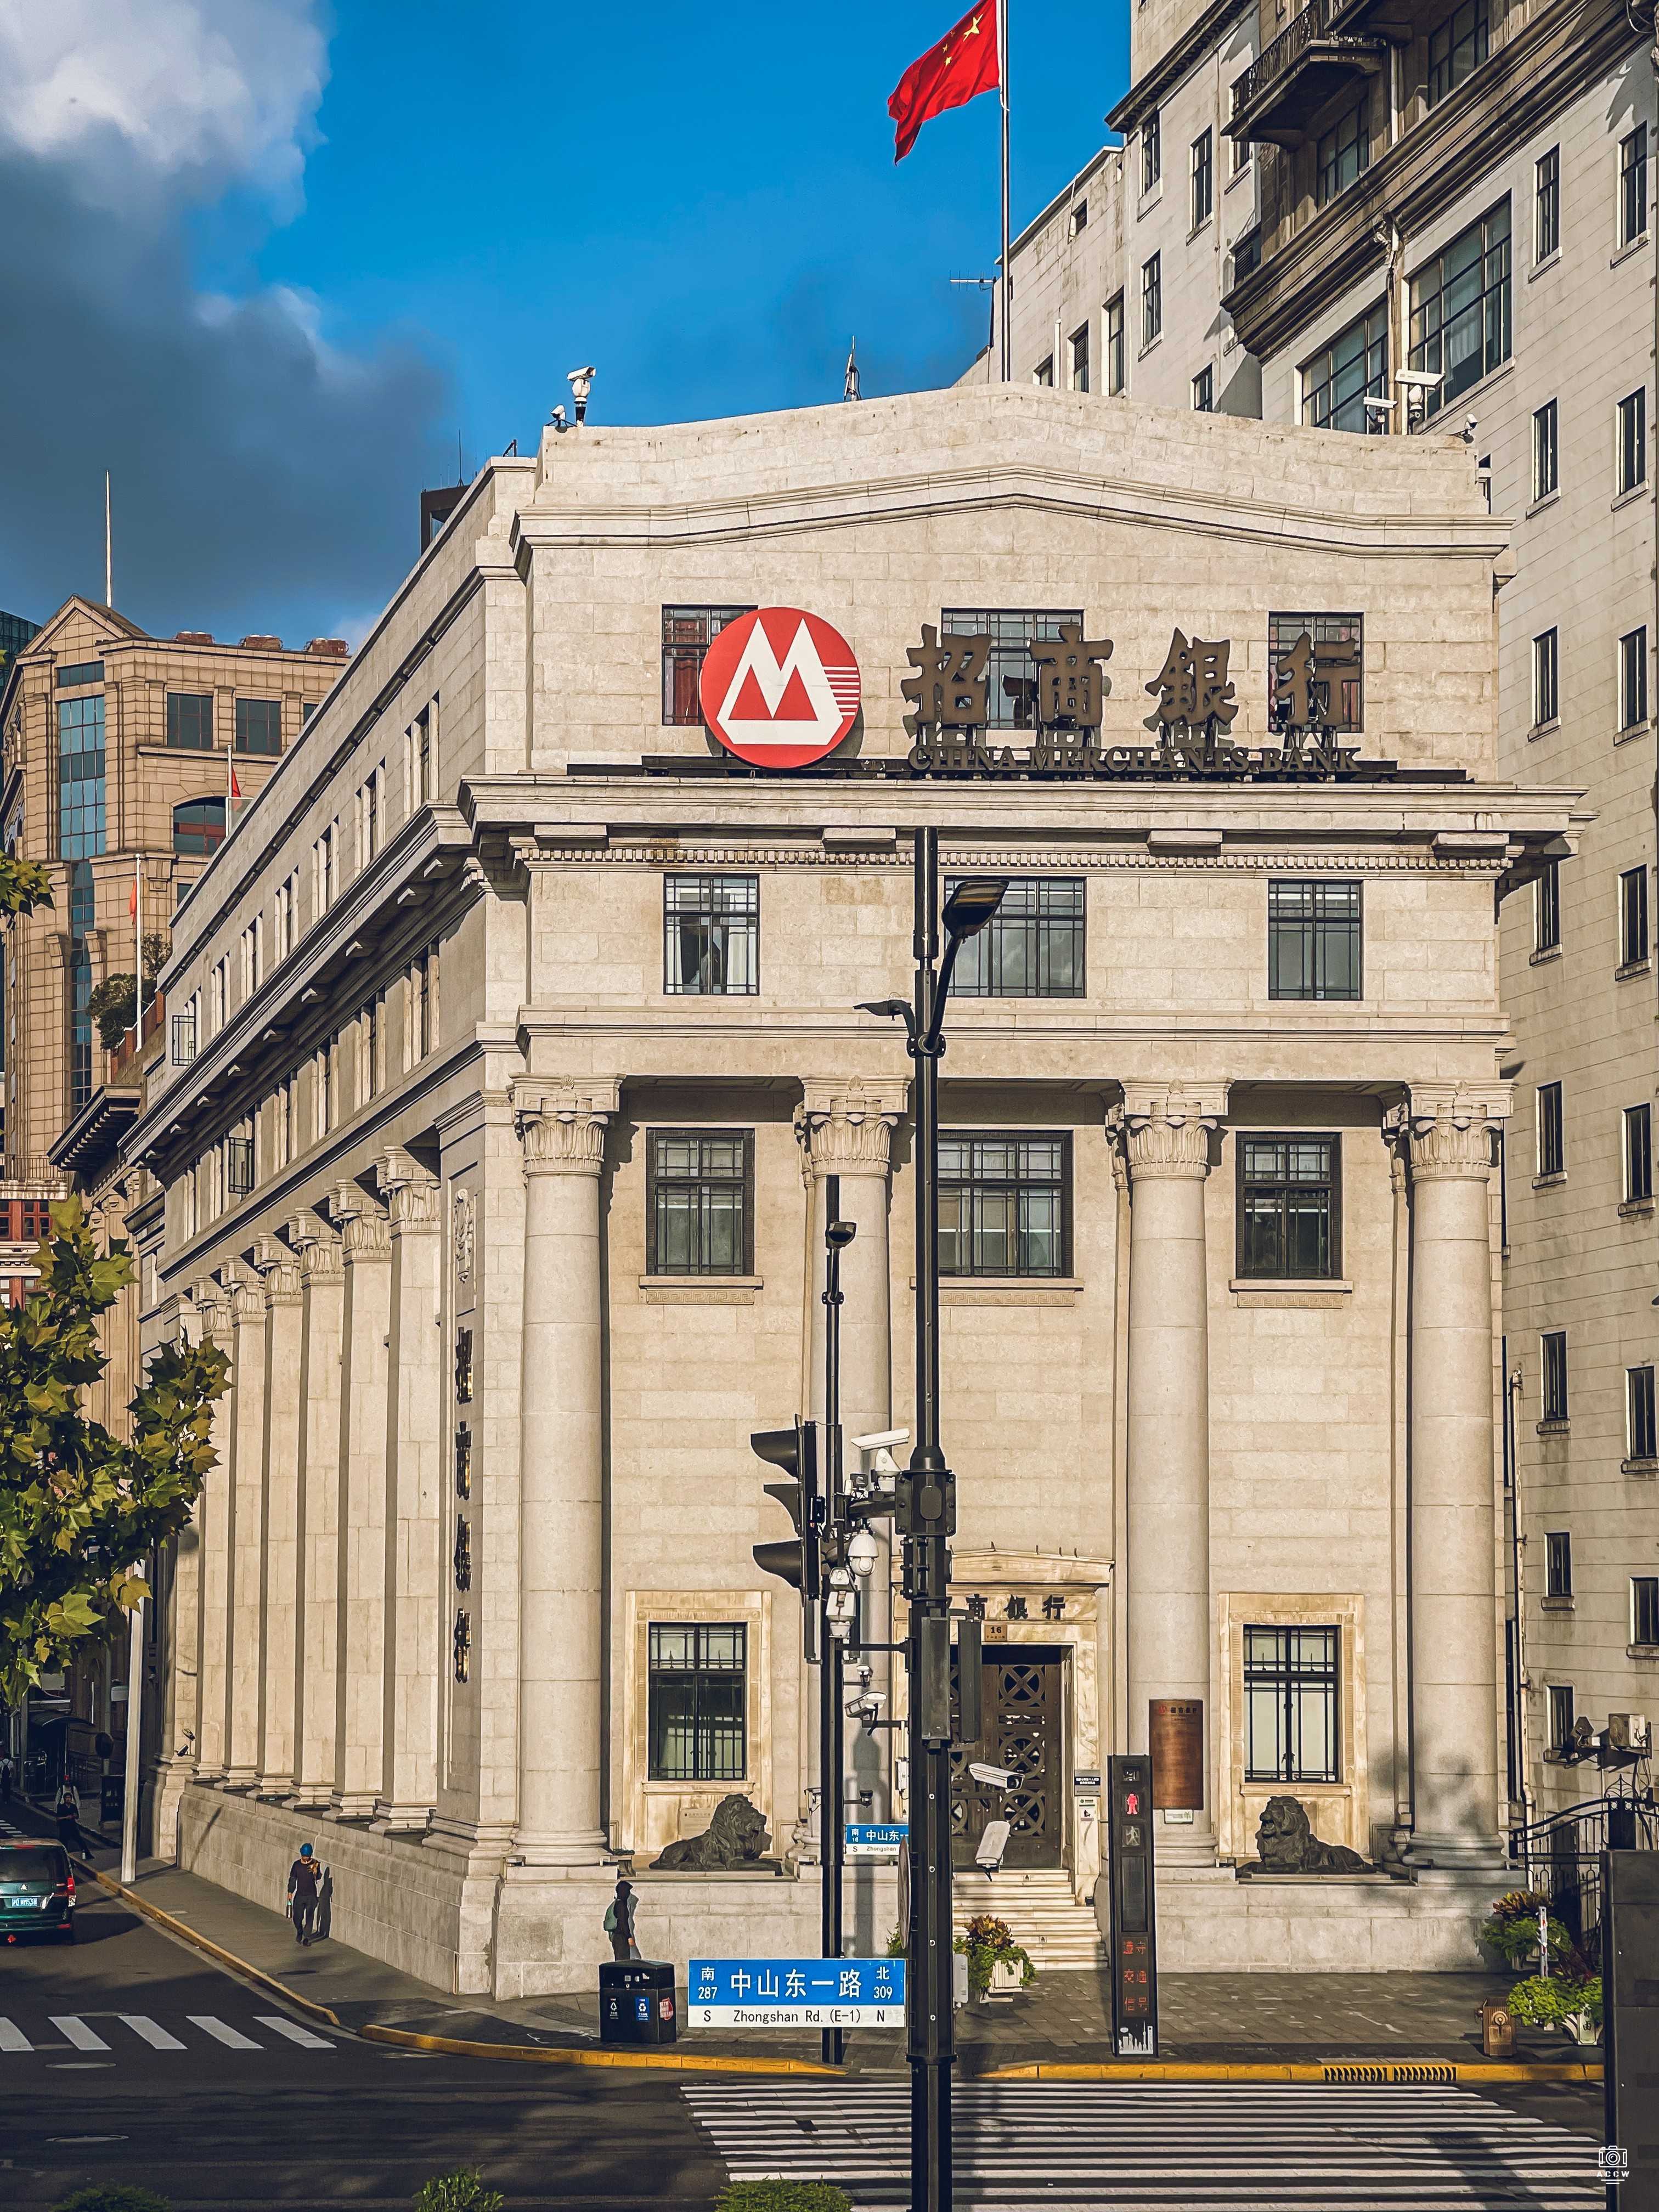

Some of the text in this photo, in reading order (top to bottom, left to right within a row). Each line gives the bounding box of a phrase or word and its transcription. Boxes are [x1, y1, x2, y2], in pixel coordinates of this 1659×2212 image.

[908, 744, 1362, 772] CHINA MERCHANTS BANK
[701, 1966, 890, 1998] 南 中山东一路 北
[698, 1986, 893, 2000] 287 309
[1125, 1996, 1147, 2011] 信号
[703, 2008, 885, 2024] S Zhongshan Rd. (E-1) N
